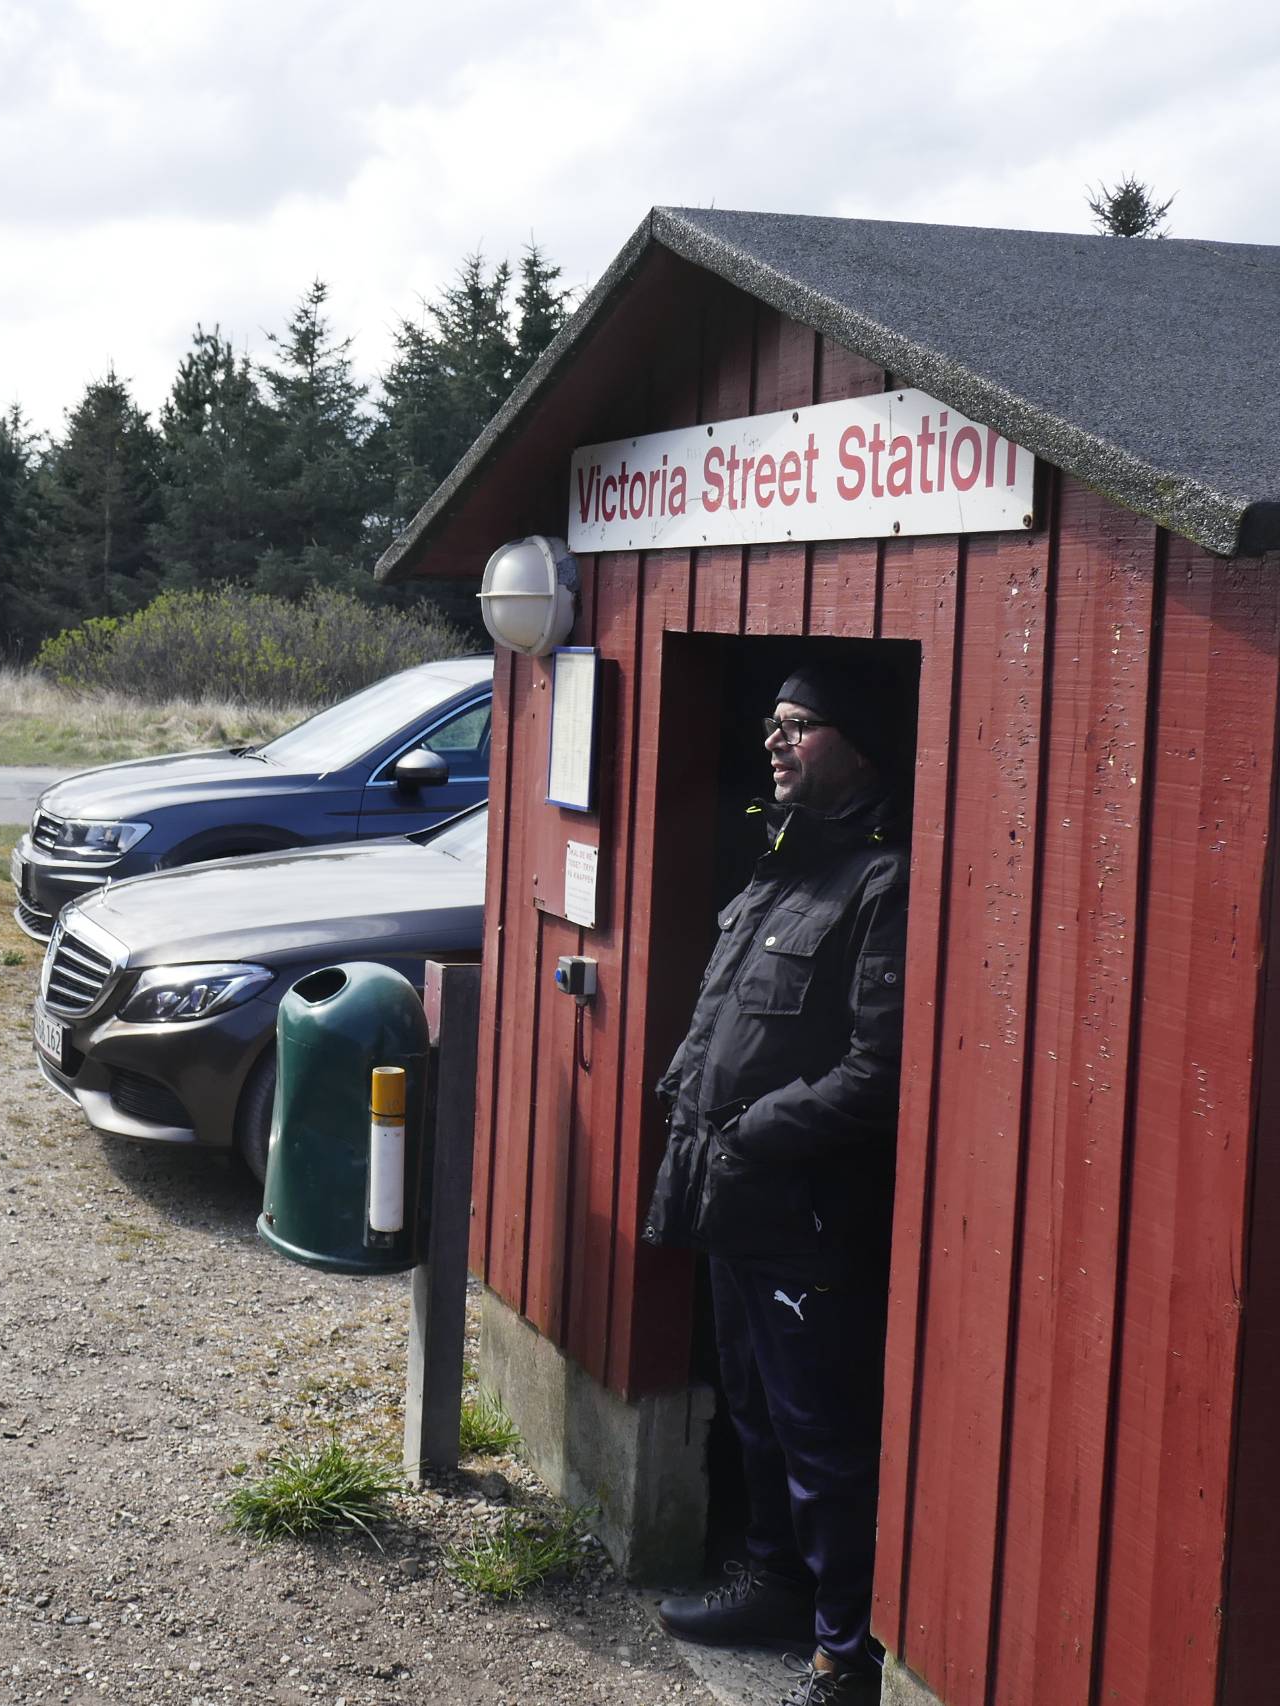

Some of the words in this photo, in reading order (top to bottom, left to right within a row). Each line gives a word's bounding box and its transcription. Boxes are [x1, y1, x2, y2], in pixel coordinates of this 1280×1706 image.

[577, 454, 687, 524] Victoria
[702, 433, 819, 513] Street
[836, 411, 1017, 501] Station
